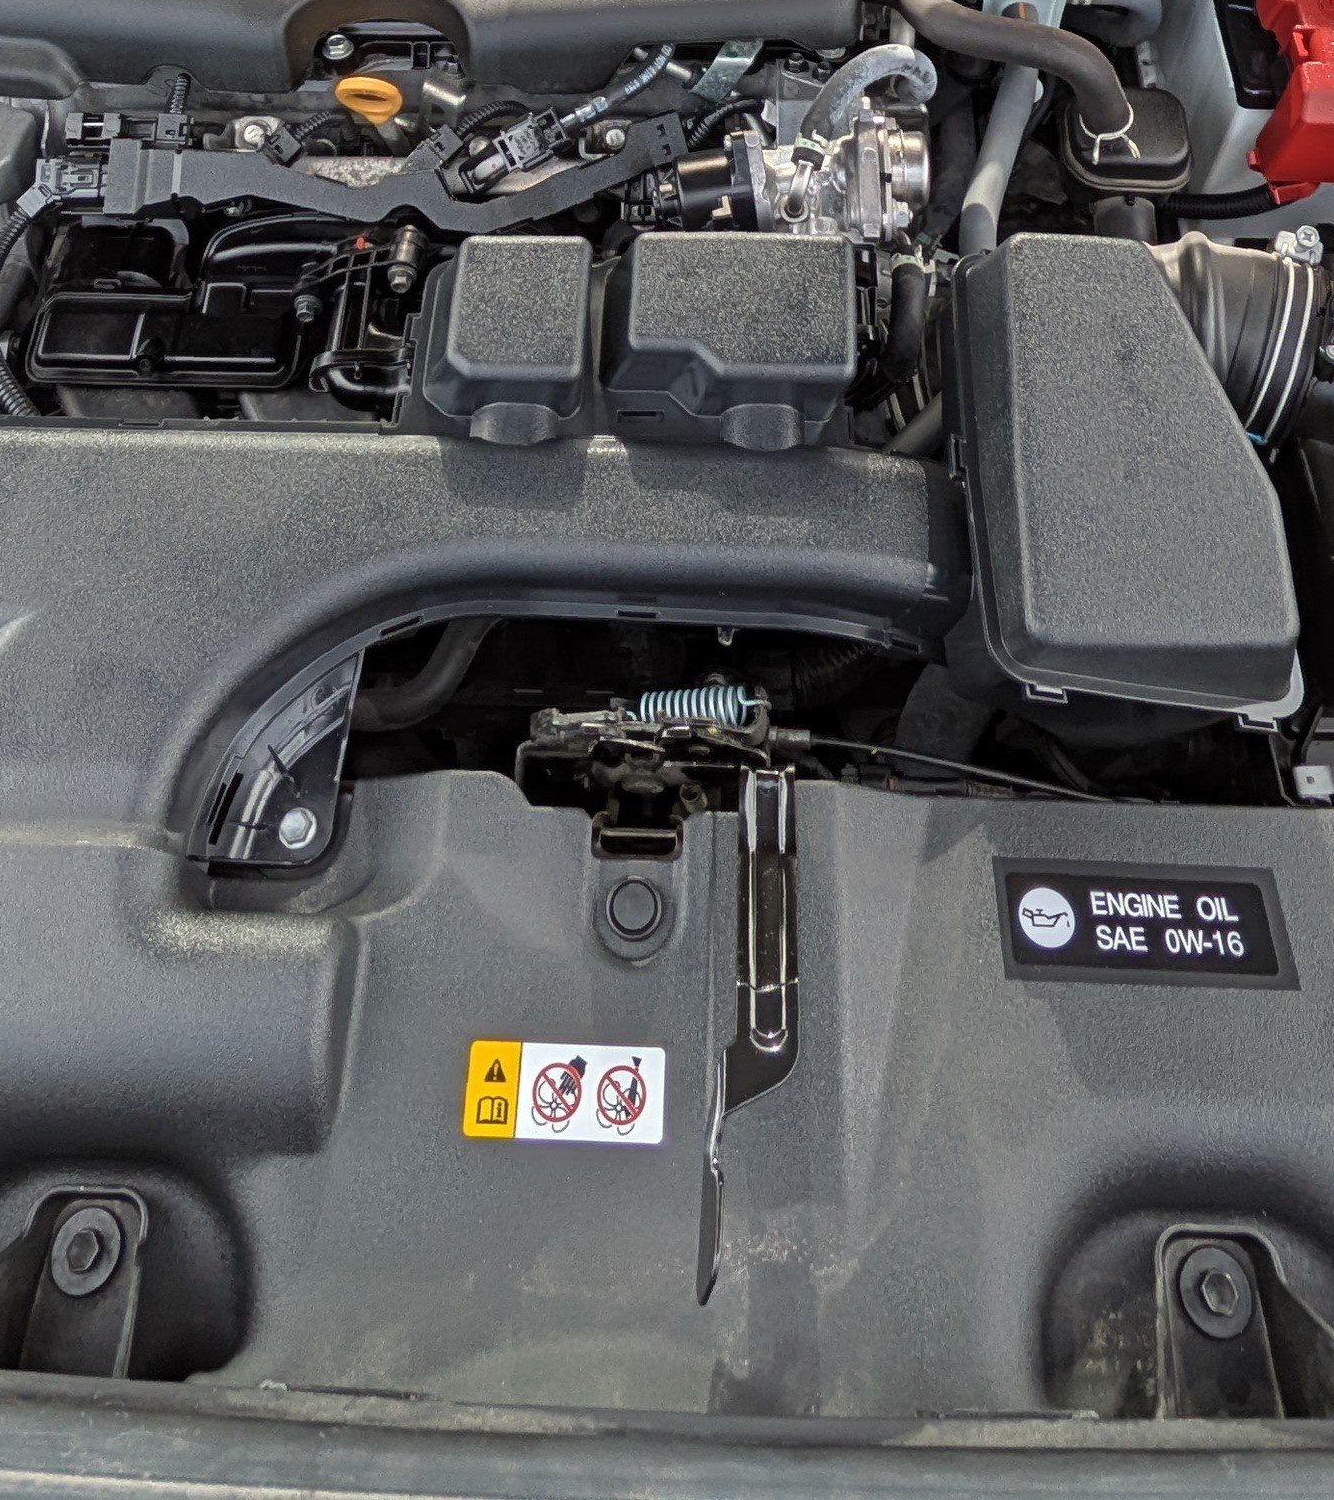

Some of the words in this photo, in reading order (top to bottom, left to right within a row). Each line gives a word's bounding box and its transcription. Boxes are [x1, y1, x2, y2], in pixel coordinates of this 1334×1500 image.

[1089, 890, 1182, 920] ENGINE
[1196, 895, 1239, 922] OIL
[1095, 924, 1149, 953] SAE
[1165, 927, 1245, 957] 0W-16
